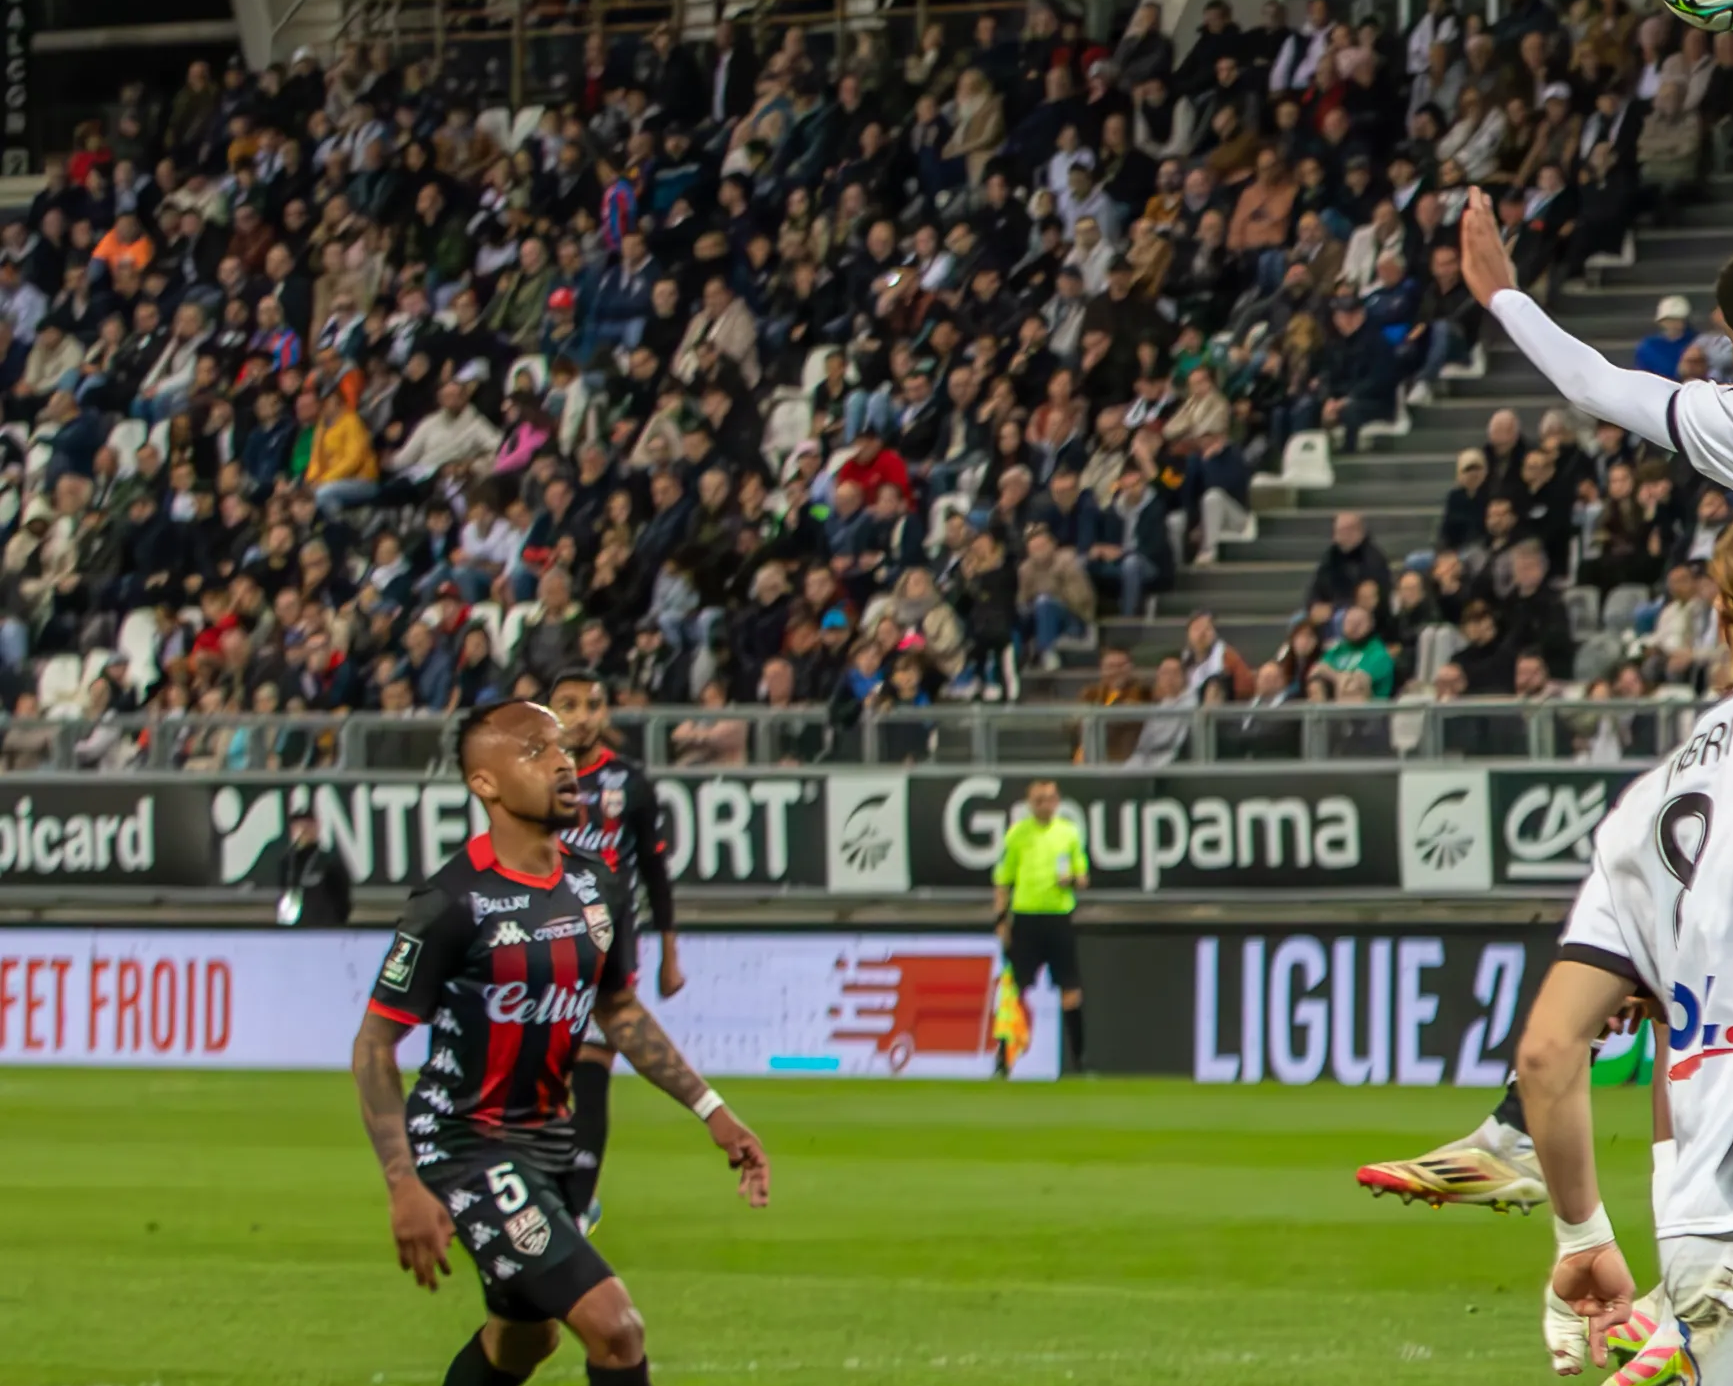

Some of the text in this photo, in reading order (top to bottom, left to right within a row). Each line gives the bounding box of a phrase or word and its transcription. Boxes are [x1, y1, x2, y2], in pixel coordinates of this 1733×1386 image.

[943, 776, 1360, 891] Gupama
[88, 957, 233, 1053] FROID
[1194, 935, 1446, 1085] LIGUE
[485, 1161, 528, 1214] 5
